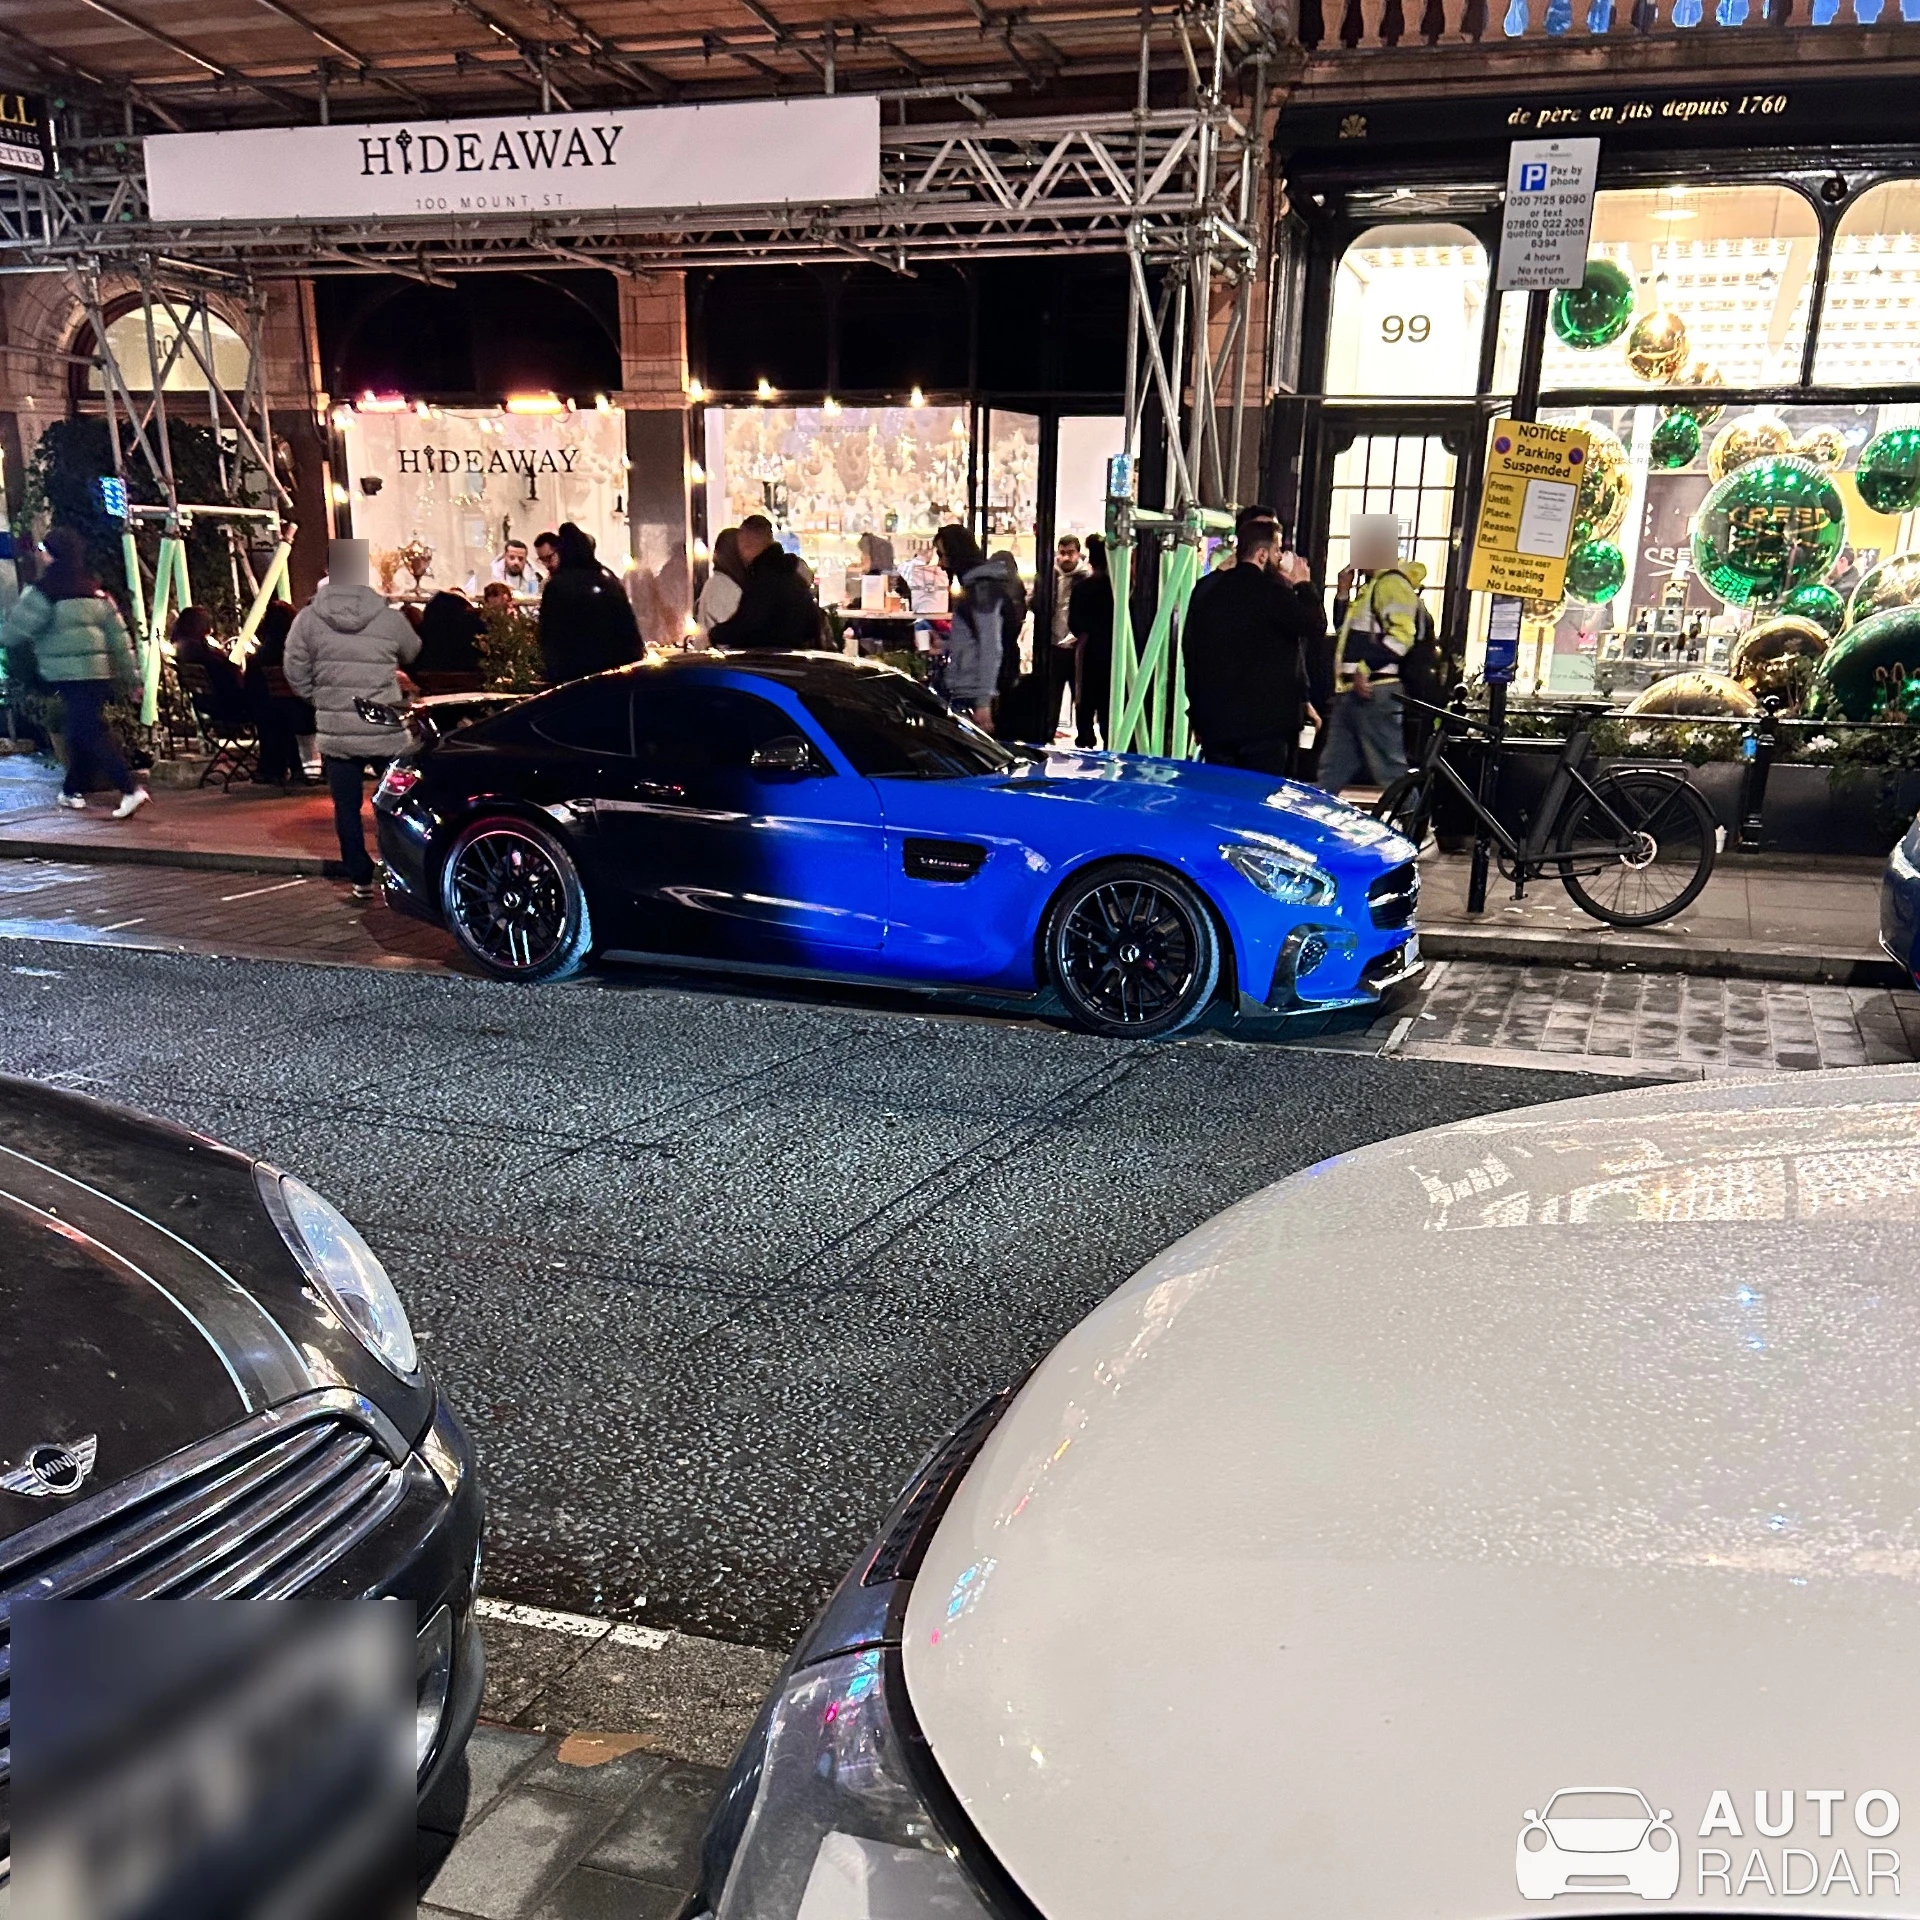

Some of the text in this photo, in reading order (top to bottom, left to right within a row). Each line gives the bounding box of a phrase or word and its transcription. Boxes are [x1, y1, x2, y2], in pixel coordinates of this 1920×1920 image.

[1507, 107, 1531, 125] de
[1535, 106, 1580, 128] père
[1589, 105, 1614, 121] en
[1662, 98, 1730, 121] depuis
[1737, 95, 1788, 115] 1760
[358, 125, 624, 176] HIDEAWAY
[1525, 165, 1544, 190] P
[1550, 165, 1583, 175] Pay by
[1550, 178, 1580, 187] phone
[416, 198, 448, 210] 100
[460, 195, 528, 209] MOUNT
[1510, 194, 1586, 206] 020 7125 9090
[1543, 208, 1562, 217] text
[1506, 218, 1585, 229] 07860 022 205
[1507, 228, 1584, 239] quoting location
[1524, 253, 1560, 261] 4 hours
[1517, 266, 1564, 275] No return
[1509, 278, 1538, 286] within
[1548, 277, 1571, 285] hour
[1382, 314, 1431, 344] 99
[1518, 424, 1567, 443] NOTICE
[397, 445, 579, 473] HIDEAWAY
[1516, 444, 1562, 464] Parking
[1502, 457, 1571, 478] Suspended
[1490, 564, 1545, 582] No waiting
[1486, 579, 1544, 598] No Loading
[36, 1454, 76, 1480] MINI
